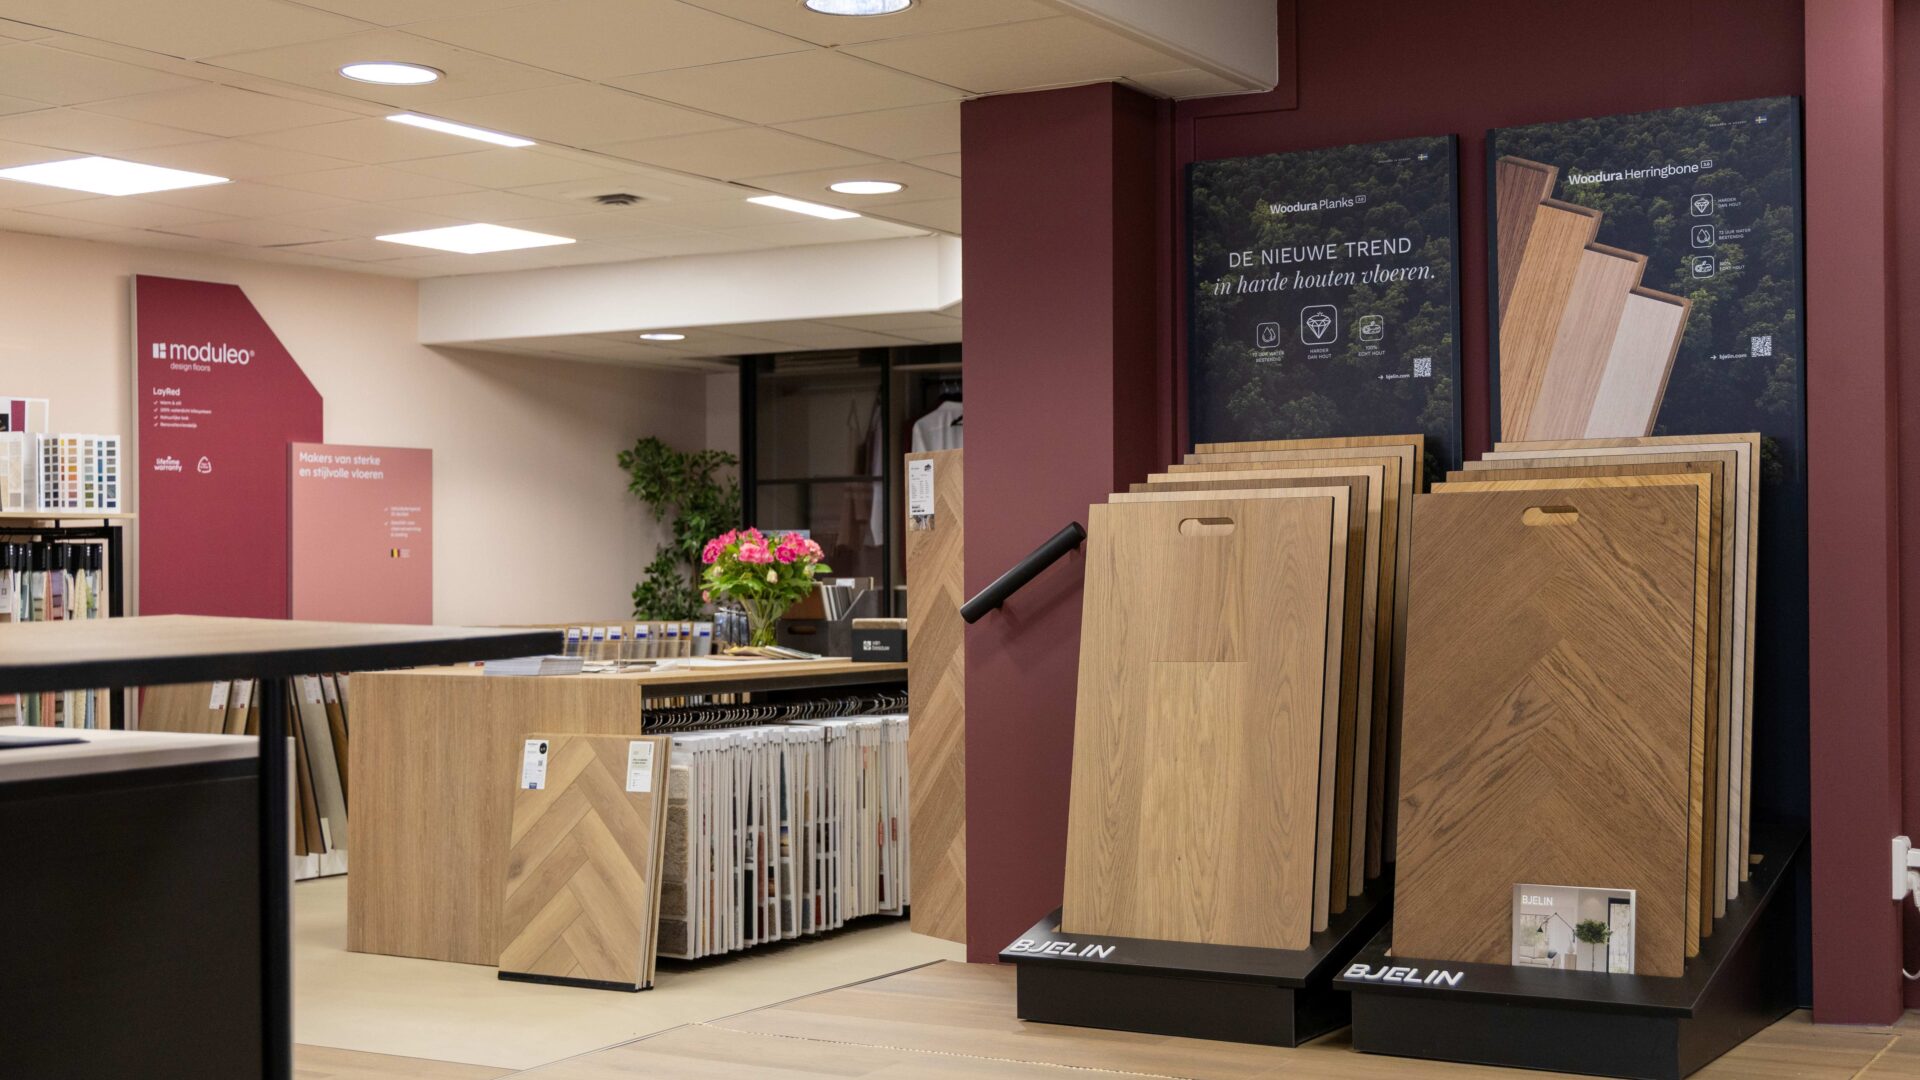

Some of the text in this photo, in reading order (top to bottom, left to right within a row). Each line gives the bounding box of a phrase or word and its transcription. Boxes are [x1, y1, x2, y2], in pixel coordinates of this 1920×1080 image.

[1568, 171, 1623, 185] Woodura
[1625, 163, 1699, 181] Herringbone
[1269, 201, 1318, 214] Woodura
[1319, 197, 1354, 210] Planks
[1229, 237, 1412, 268] DE NIEUWE TREND
[1213, 263, 1435, 296] in harde houten vloeren.
[170, 362, 211, 372] design floors
[153, 387, 180, 397] LayRed
[299, 452, 381, 466] Makers van sterke
[299, 467, 384, 480] en stijlvolle vloeren
[1522, 895, 1553, 906] BJELIN
[1008, 938, 1115, 960] BJELIN
[1342, 963, 1464, 986] BJELIN
